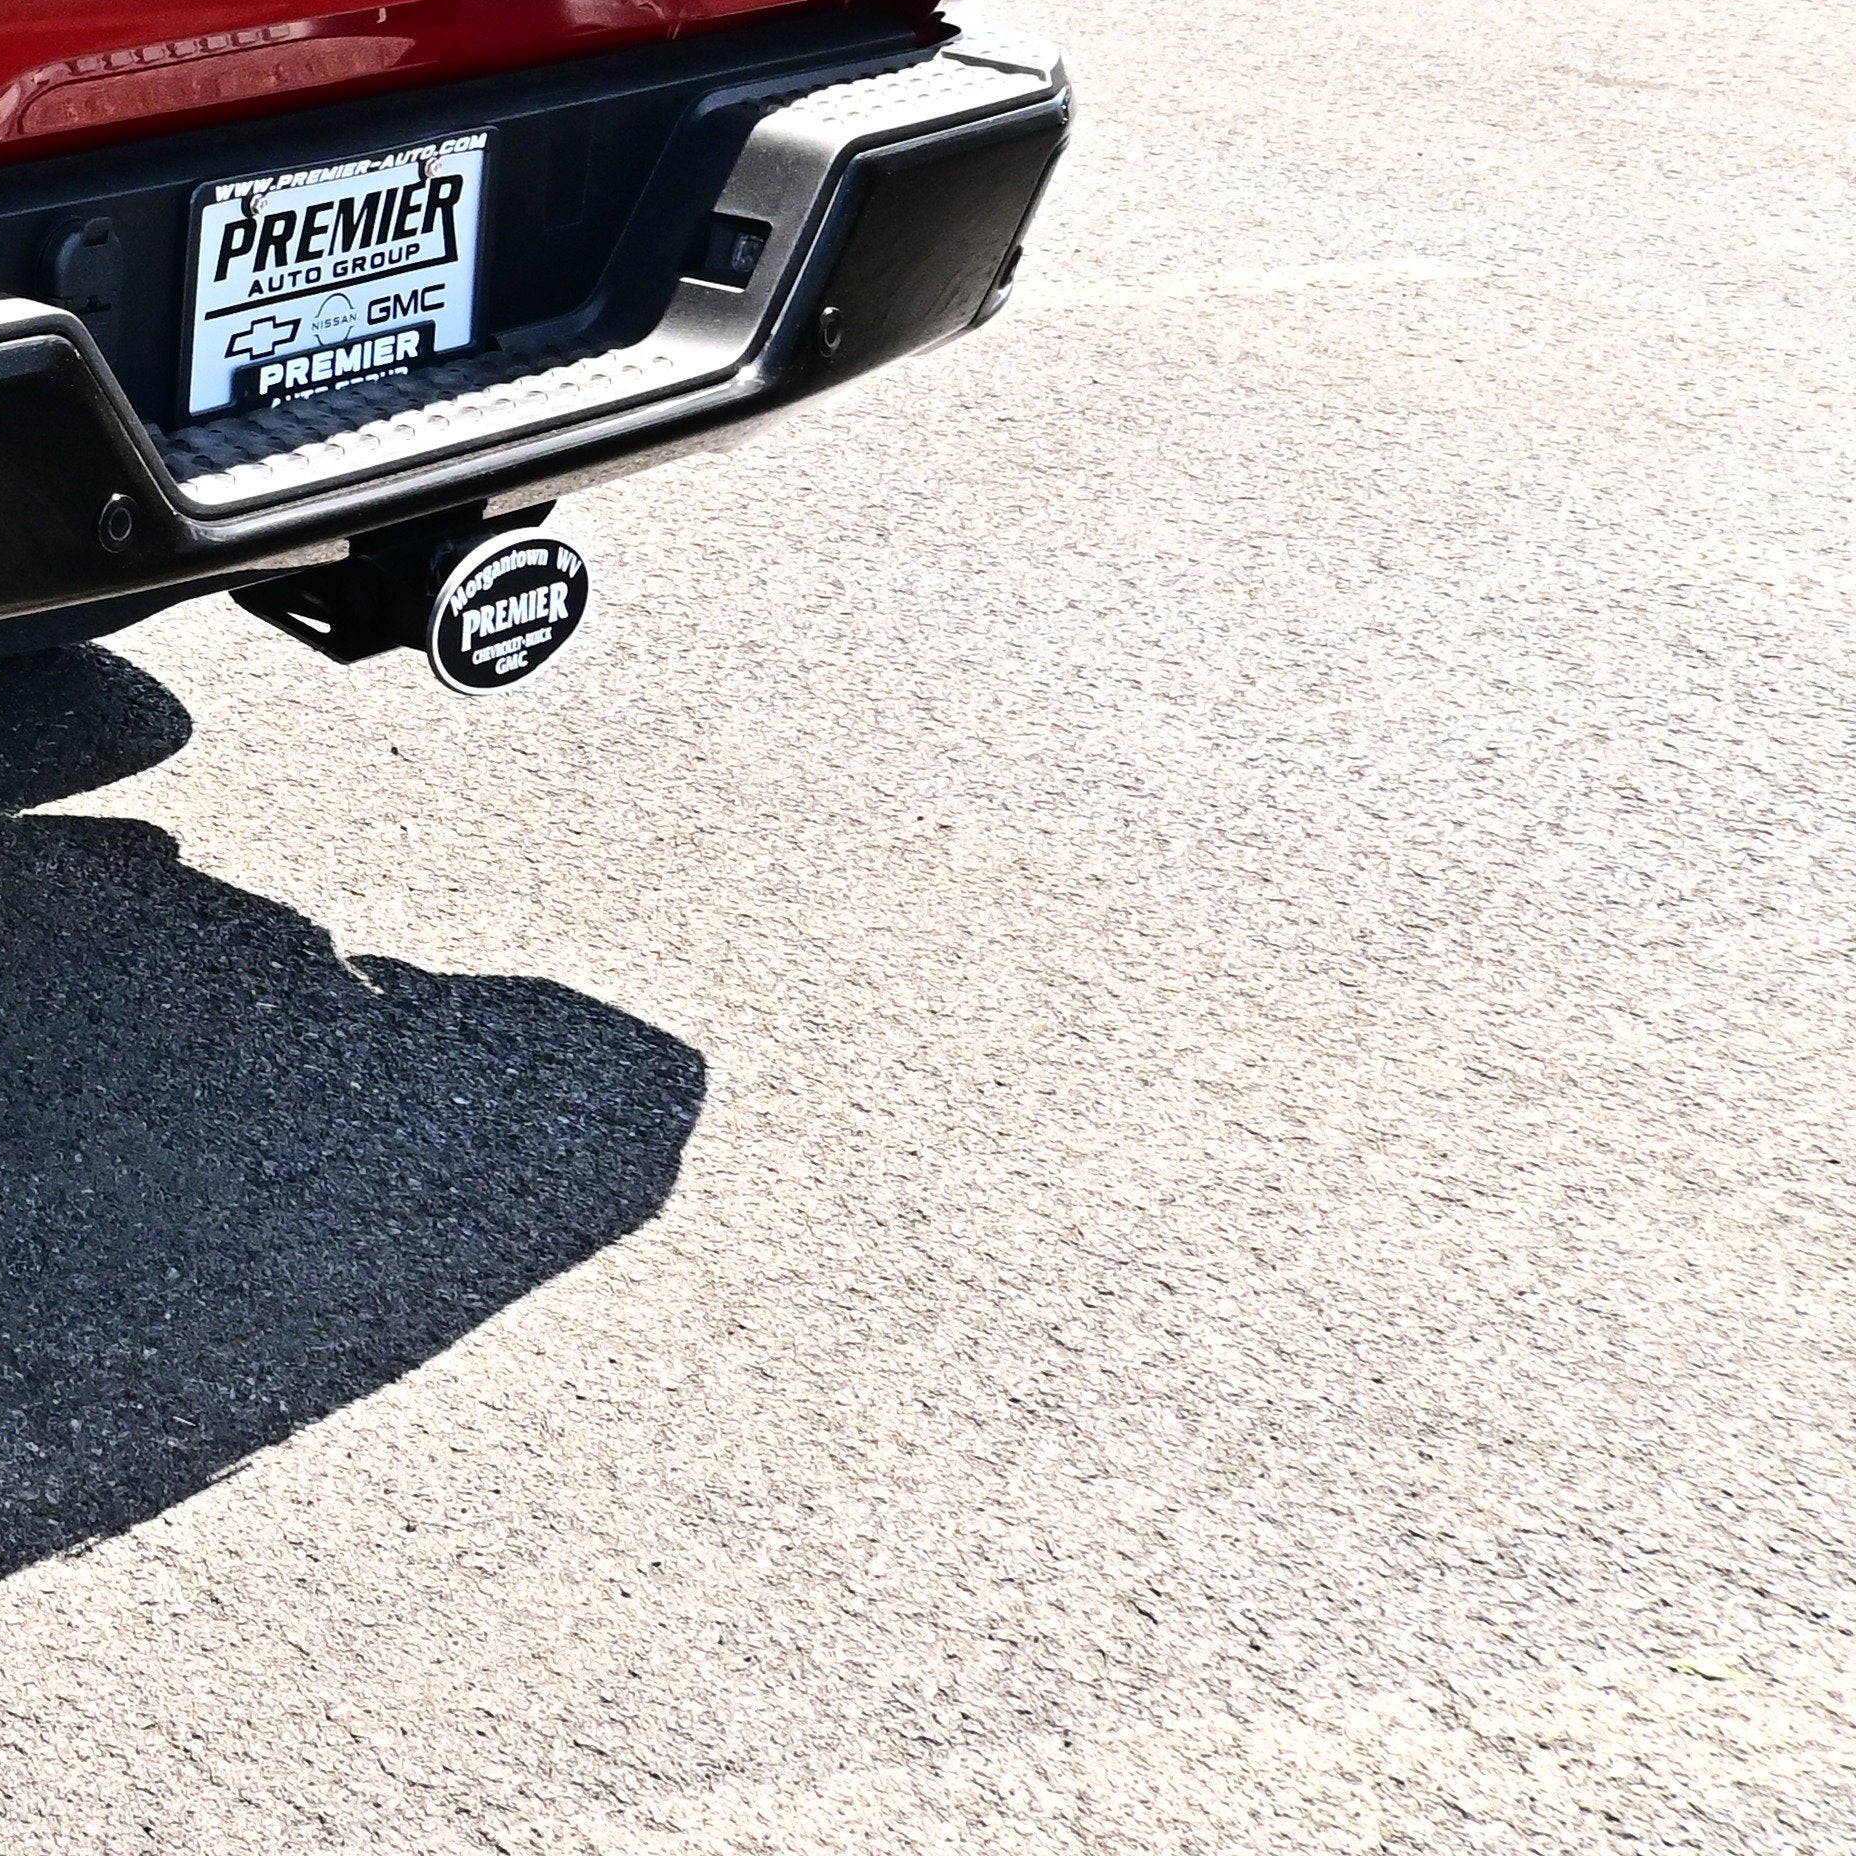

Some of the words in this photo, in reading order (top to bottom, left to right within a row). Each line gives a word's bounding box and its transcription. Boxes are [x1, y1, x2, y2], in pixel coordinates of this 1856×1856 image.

[214, 132, 488, 202] WWW.PREMIER-AUTO.COM
[213, 174, 464, 282] PREMIER
[248, 265, 321, 297] AUTO
[332, 243, 421, 278] GROUP
[311, 313, 357, 331] NISSAN
[367, 283, 446, 326] GMC
[259, 330, 420, 396] PREMIER
[450, 548, 549, 617] Morgantown
[556, 546, 583, 579] WV
[461, 581, 569, 652] PREMIER
[495, 650, 529, 675] GMC
